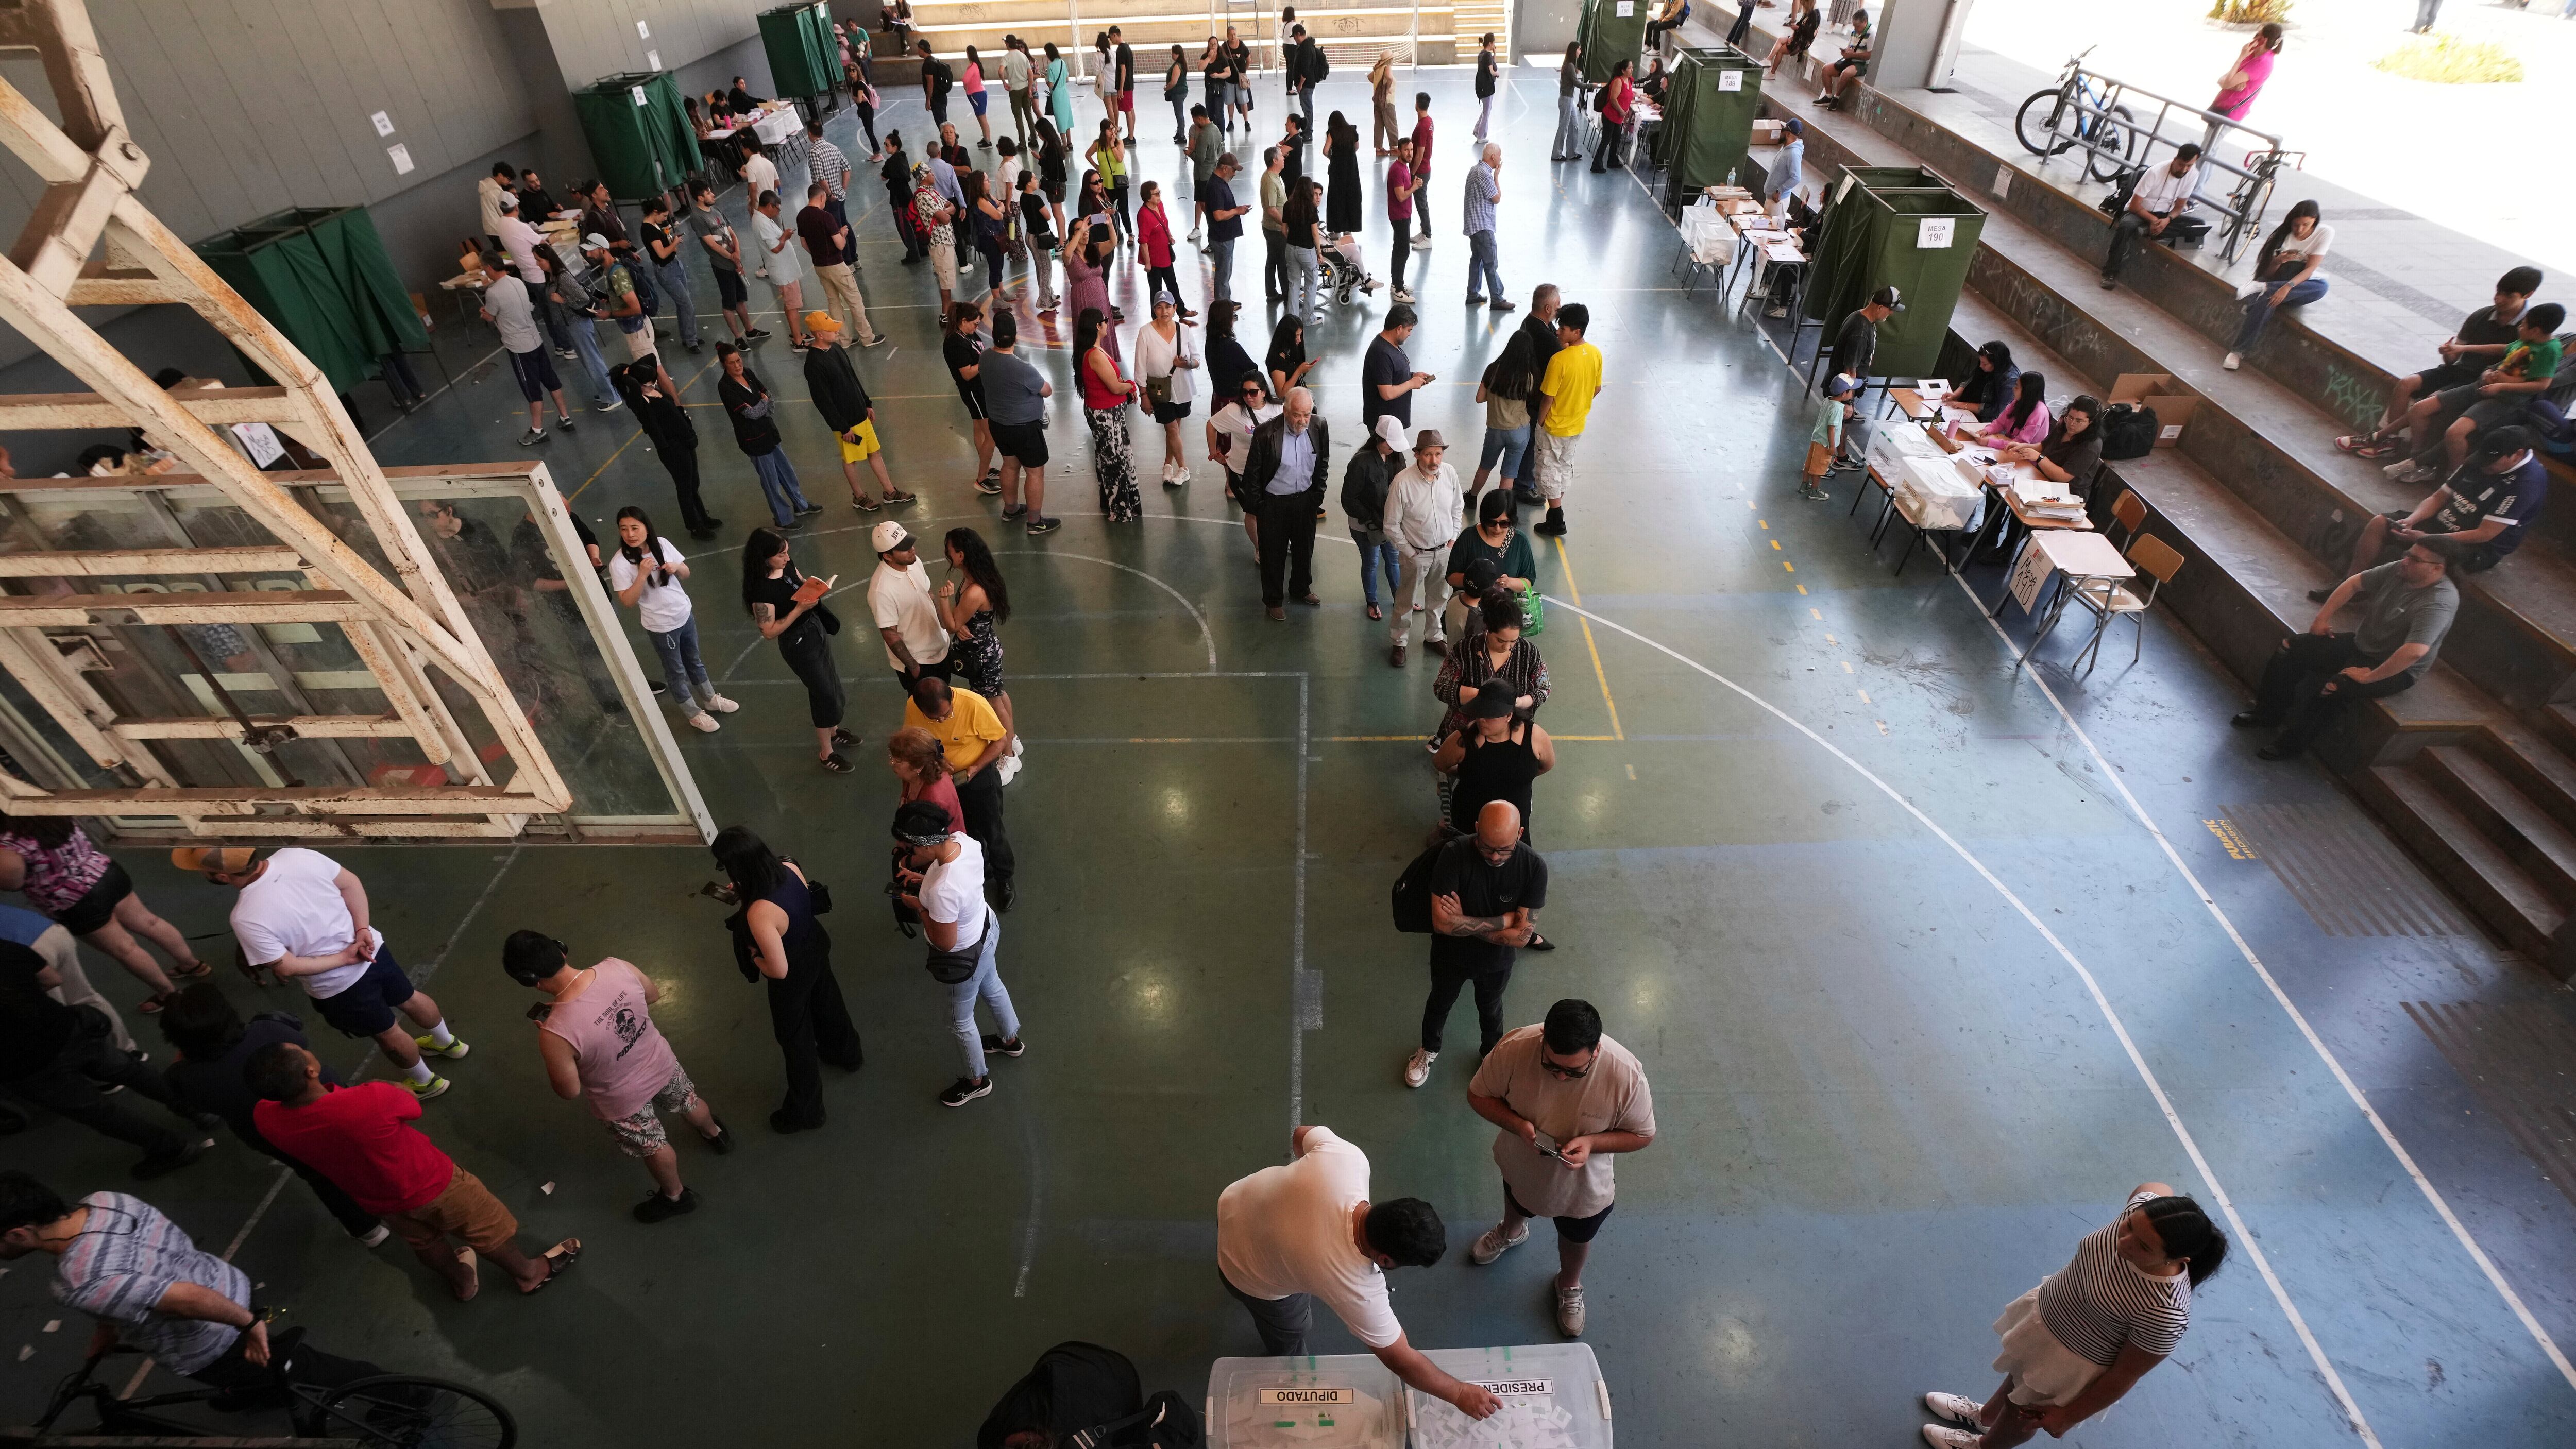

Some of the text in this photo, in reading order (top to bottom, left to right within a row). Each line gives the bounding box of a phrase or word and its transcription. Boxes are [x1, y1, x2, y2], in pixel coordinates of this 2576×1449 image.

[1928, 233, 1944, 241] 190
[1875, 446, 1889, 463] PRESIDENTE
[1905, 484, 1918, 499] DIPUTADO
[891, 530, 899, 540] NEW
[2014, 571, 2032, 605] 190
[2202, 819, 2246, 859] PULASTIC
[2217, 820, 2256, 859] BRONSON
[594, 990, 628, 1026] THE SOUL OF LIFE
[1483, 1382, 1545, 1393] PRESIDEN
[1277, 1391, 1337, 1401] DIPUTADO
